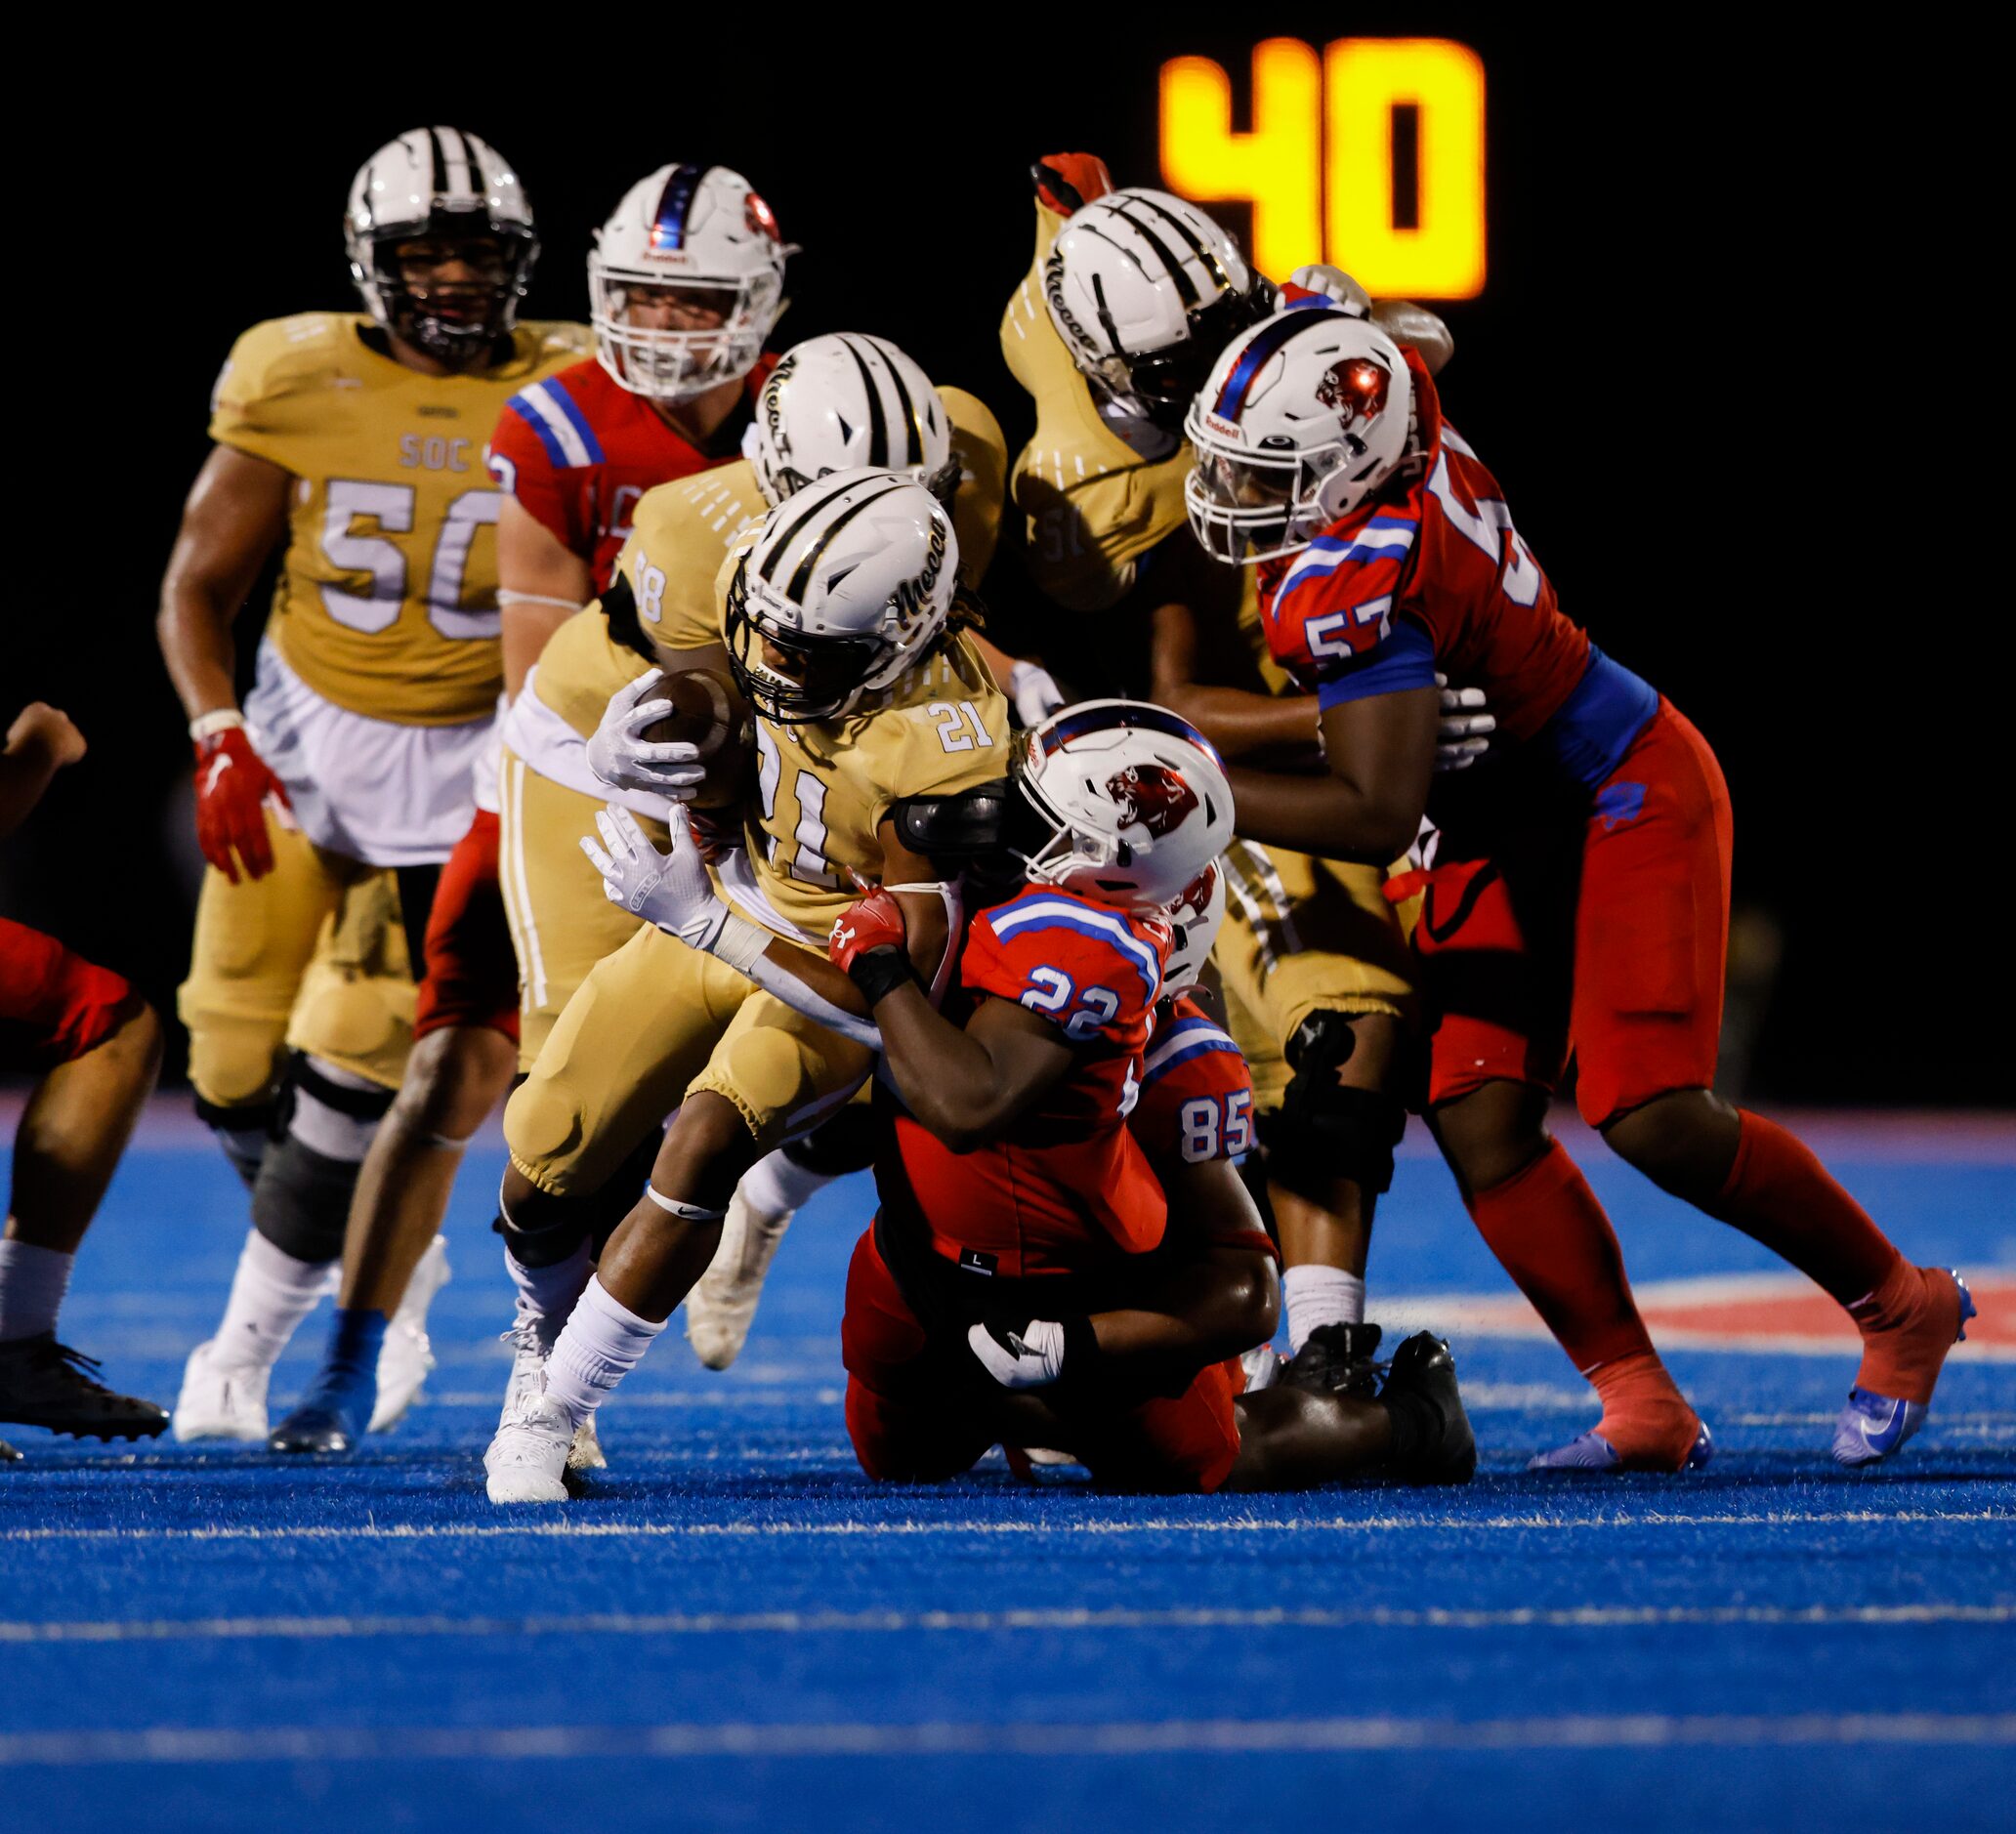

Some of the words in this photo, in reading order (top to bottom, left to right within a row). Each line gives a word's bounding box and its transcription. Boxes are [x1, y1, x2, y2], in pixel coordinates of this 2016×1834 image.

[1159, 37, 1487, 299] 40
[399, 434, 470, 473] SOC
[1304, 593, 1394, 672] 57
[927, 699, 994, 753] 21
[1020, 964, 1121, 1042] 22
[1178, 1088, 1251, 1164] 85
